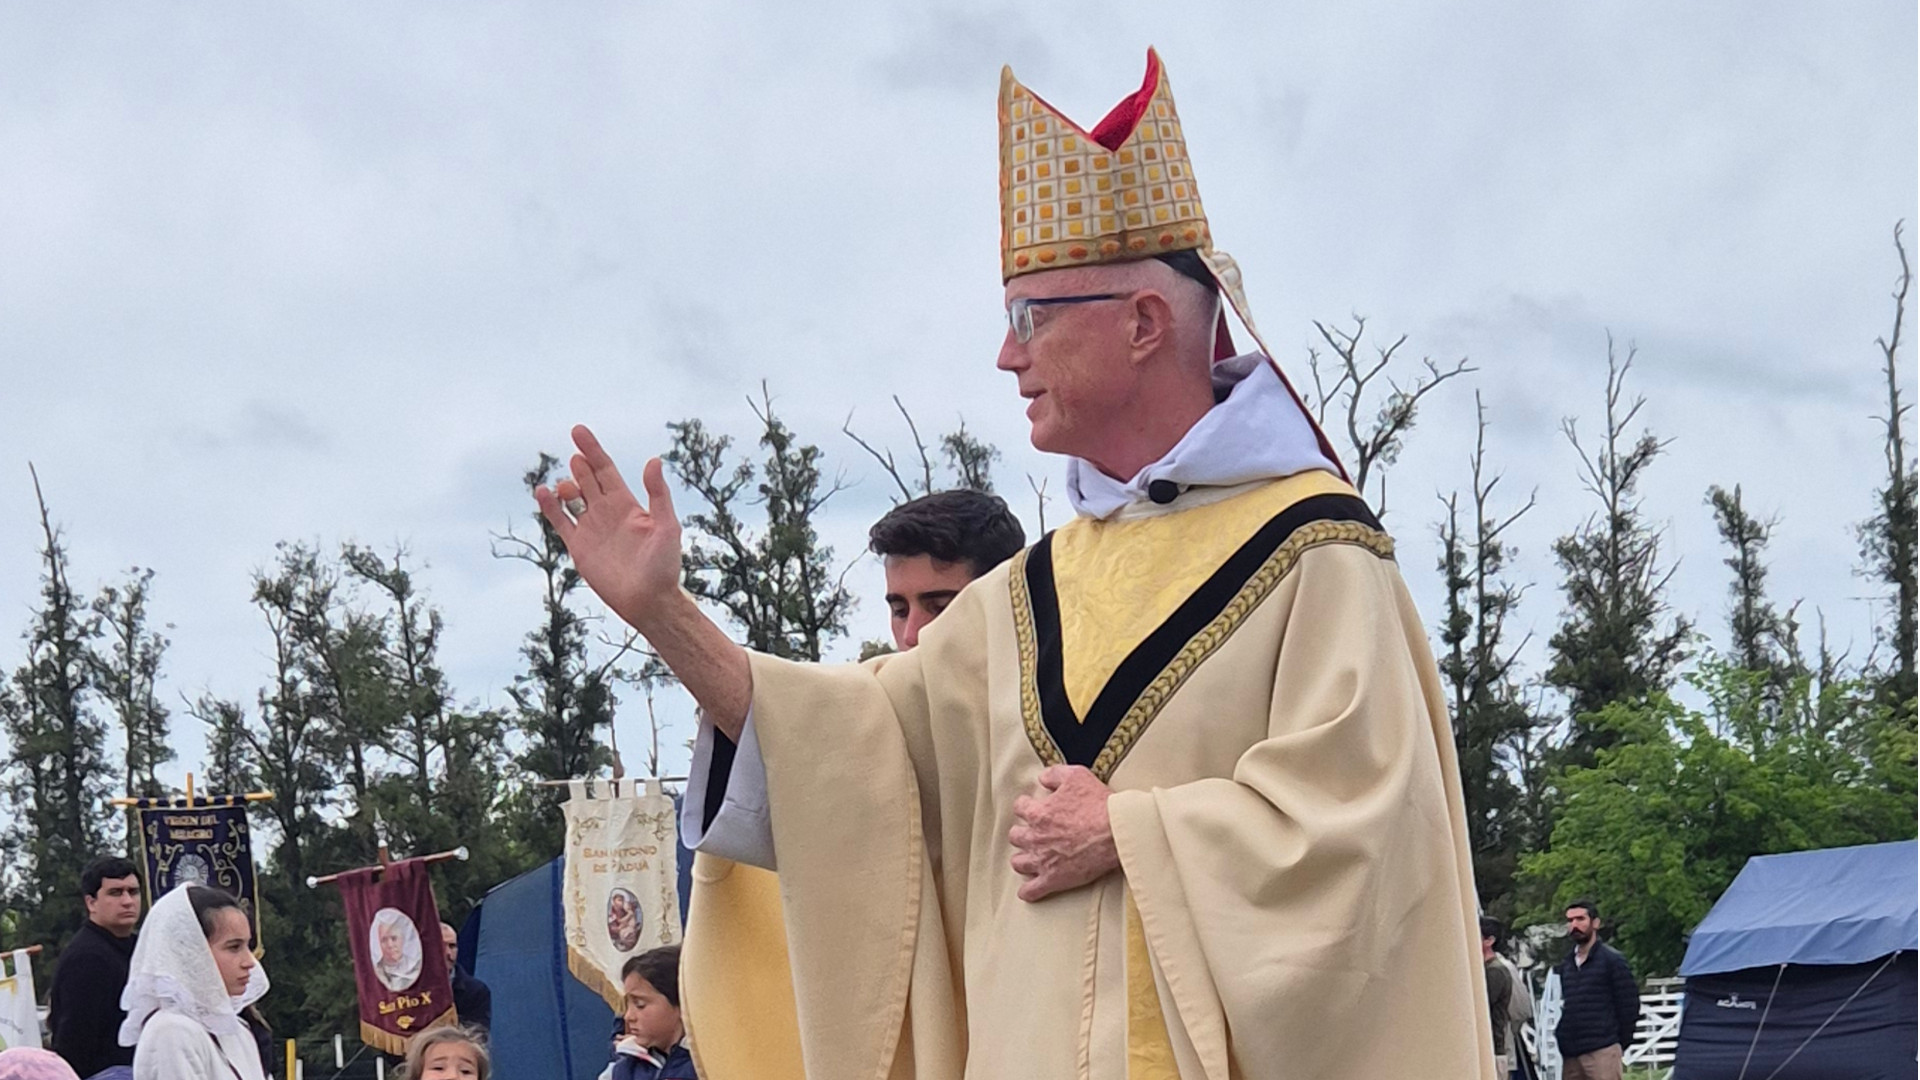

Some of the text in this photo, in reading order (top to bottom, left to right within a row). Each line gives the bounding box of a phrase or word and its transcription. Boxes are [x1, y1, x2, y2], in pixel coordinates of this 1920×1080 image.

[583, 847, 608, 859] SAN
[593, 863, 607, 873] DE
[396, 996, 420, 1010] Pio
[420, 990, 432, 1006] X
